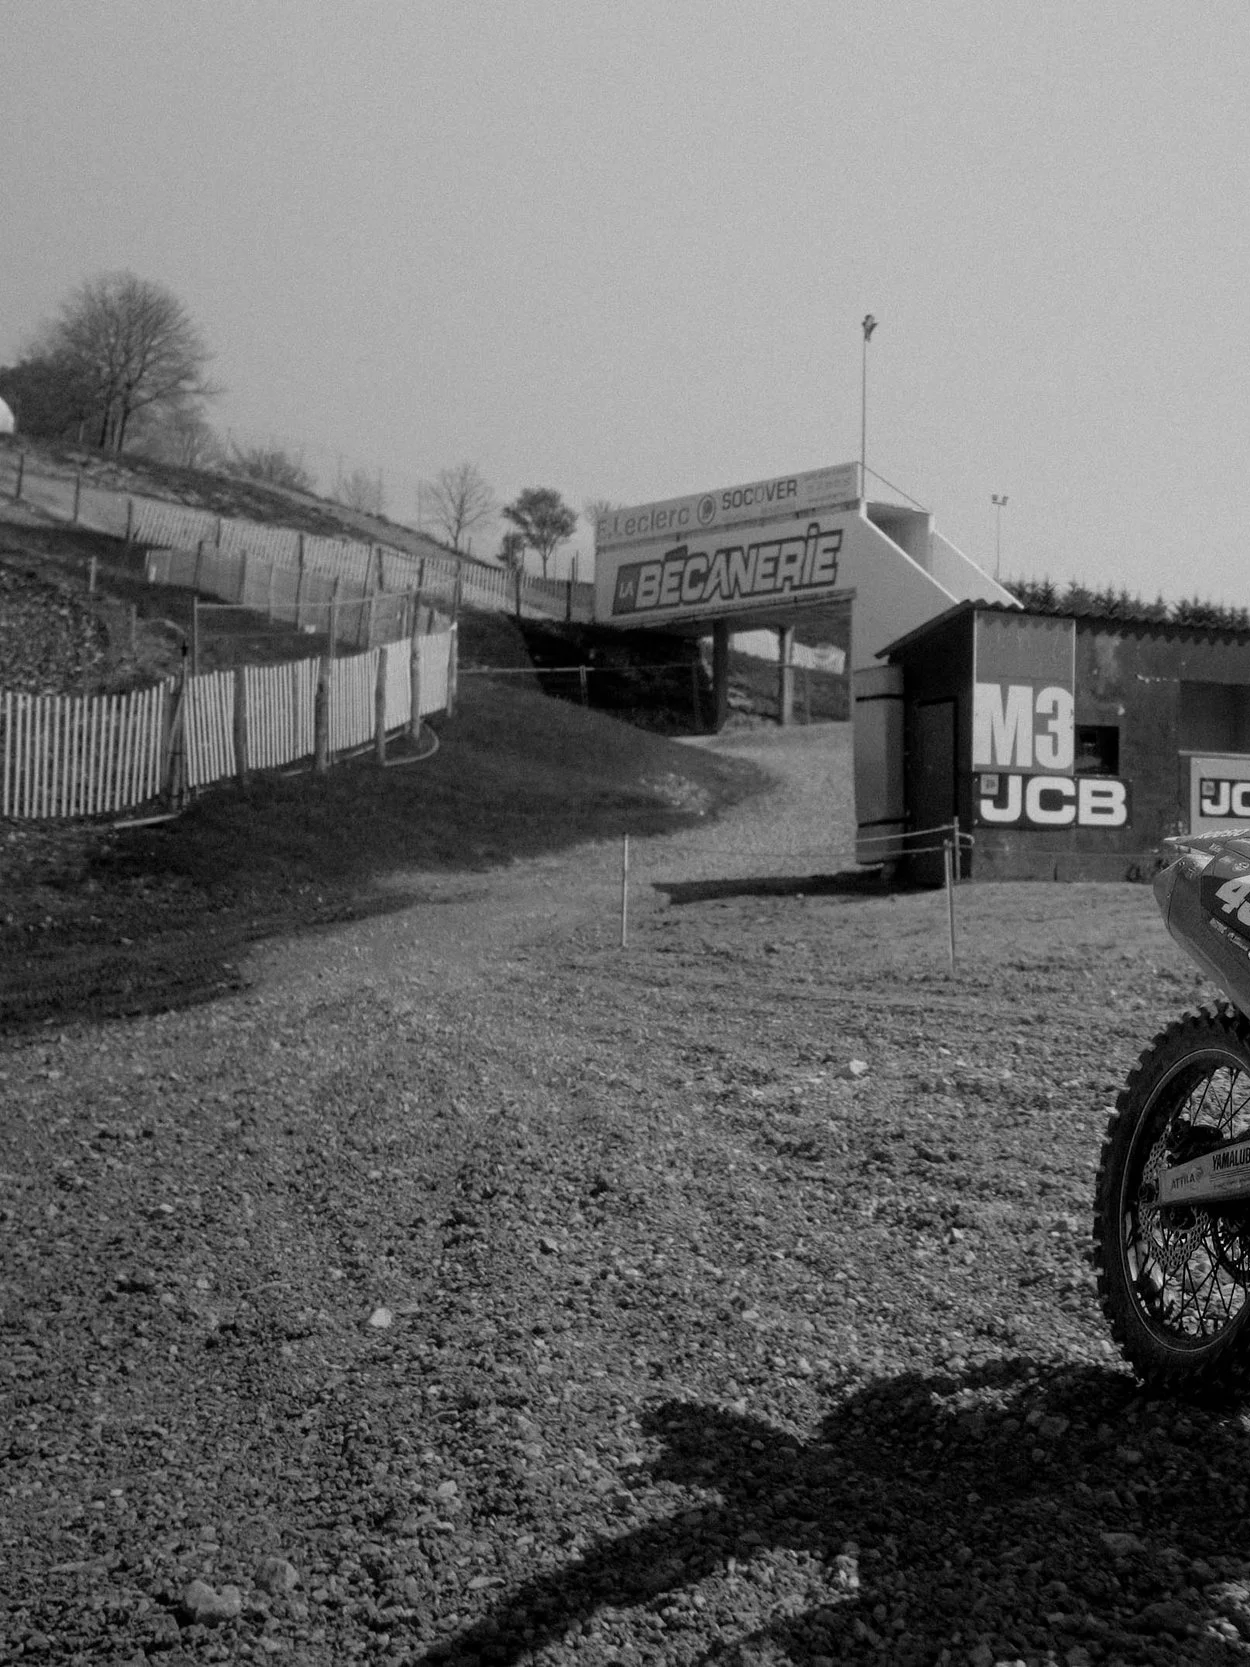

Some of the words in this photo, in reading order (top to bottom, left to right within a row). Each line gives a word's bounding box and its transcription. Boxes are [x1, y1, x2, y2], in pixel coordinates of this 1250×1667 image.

[722, 480, 797, 510] SOCOVER
[972, 682, 1075, 769] M3
[980, 775, 1127, 826] JCB
